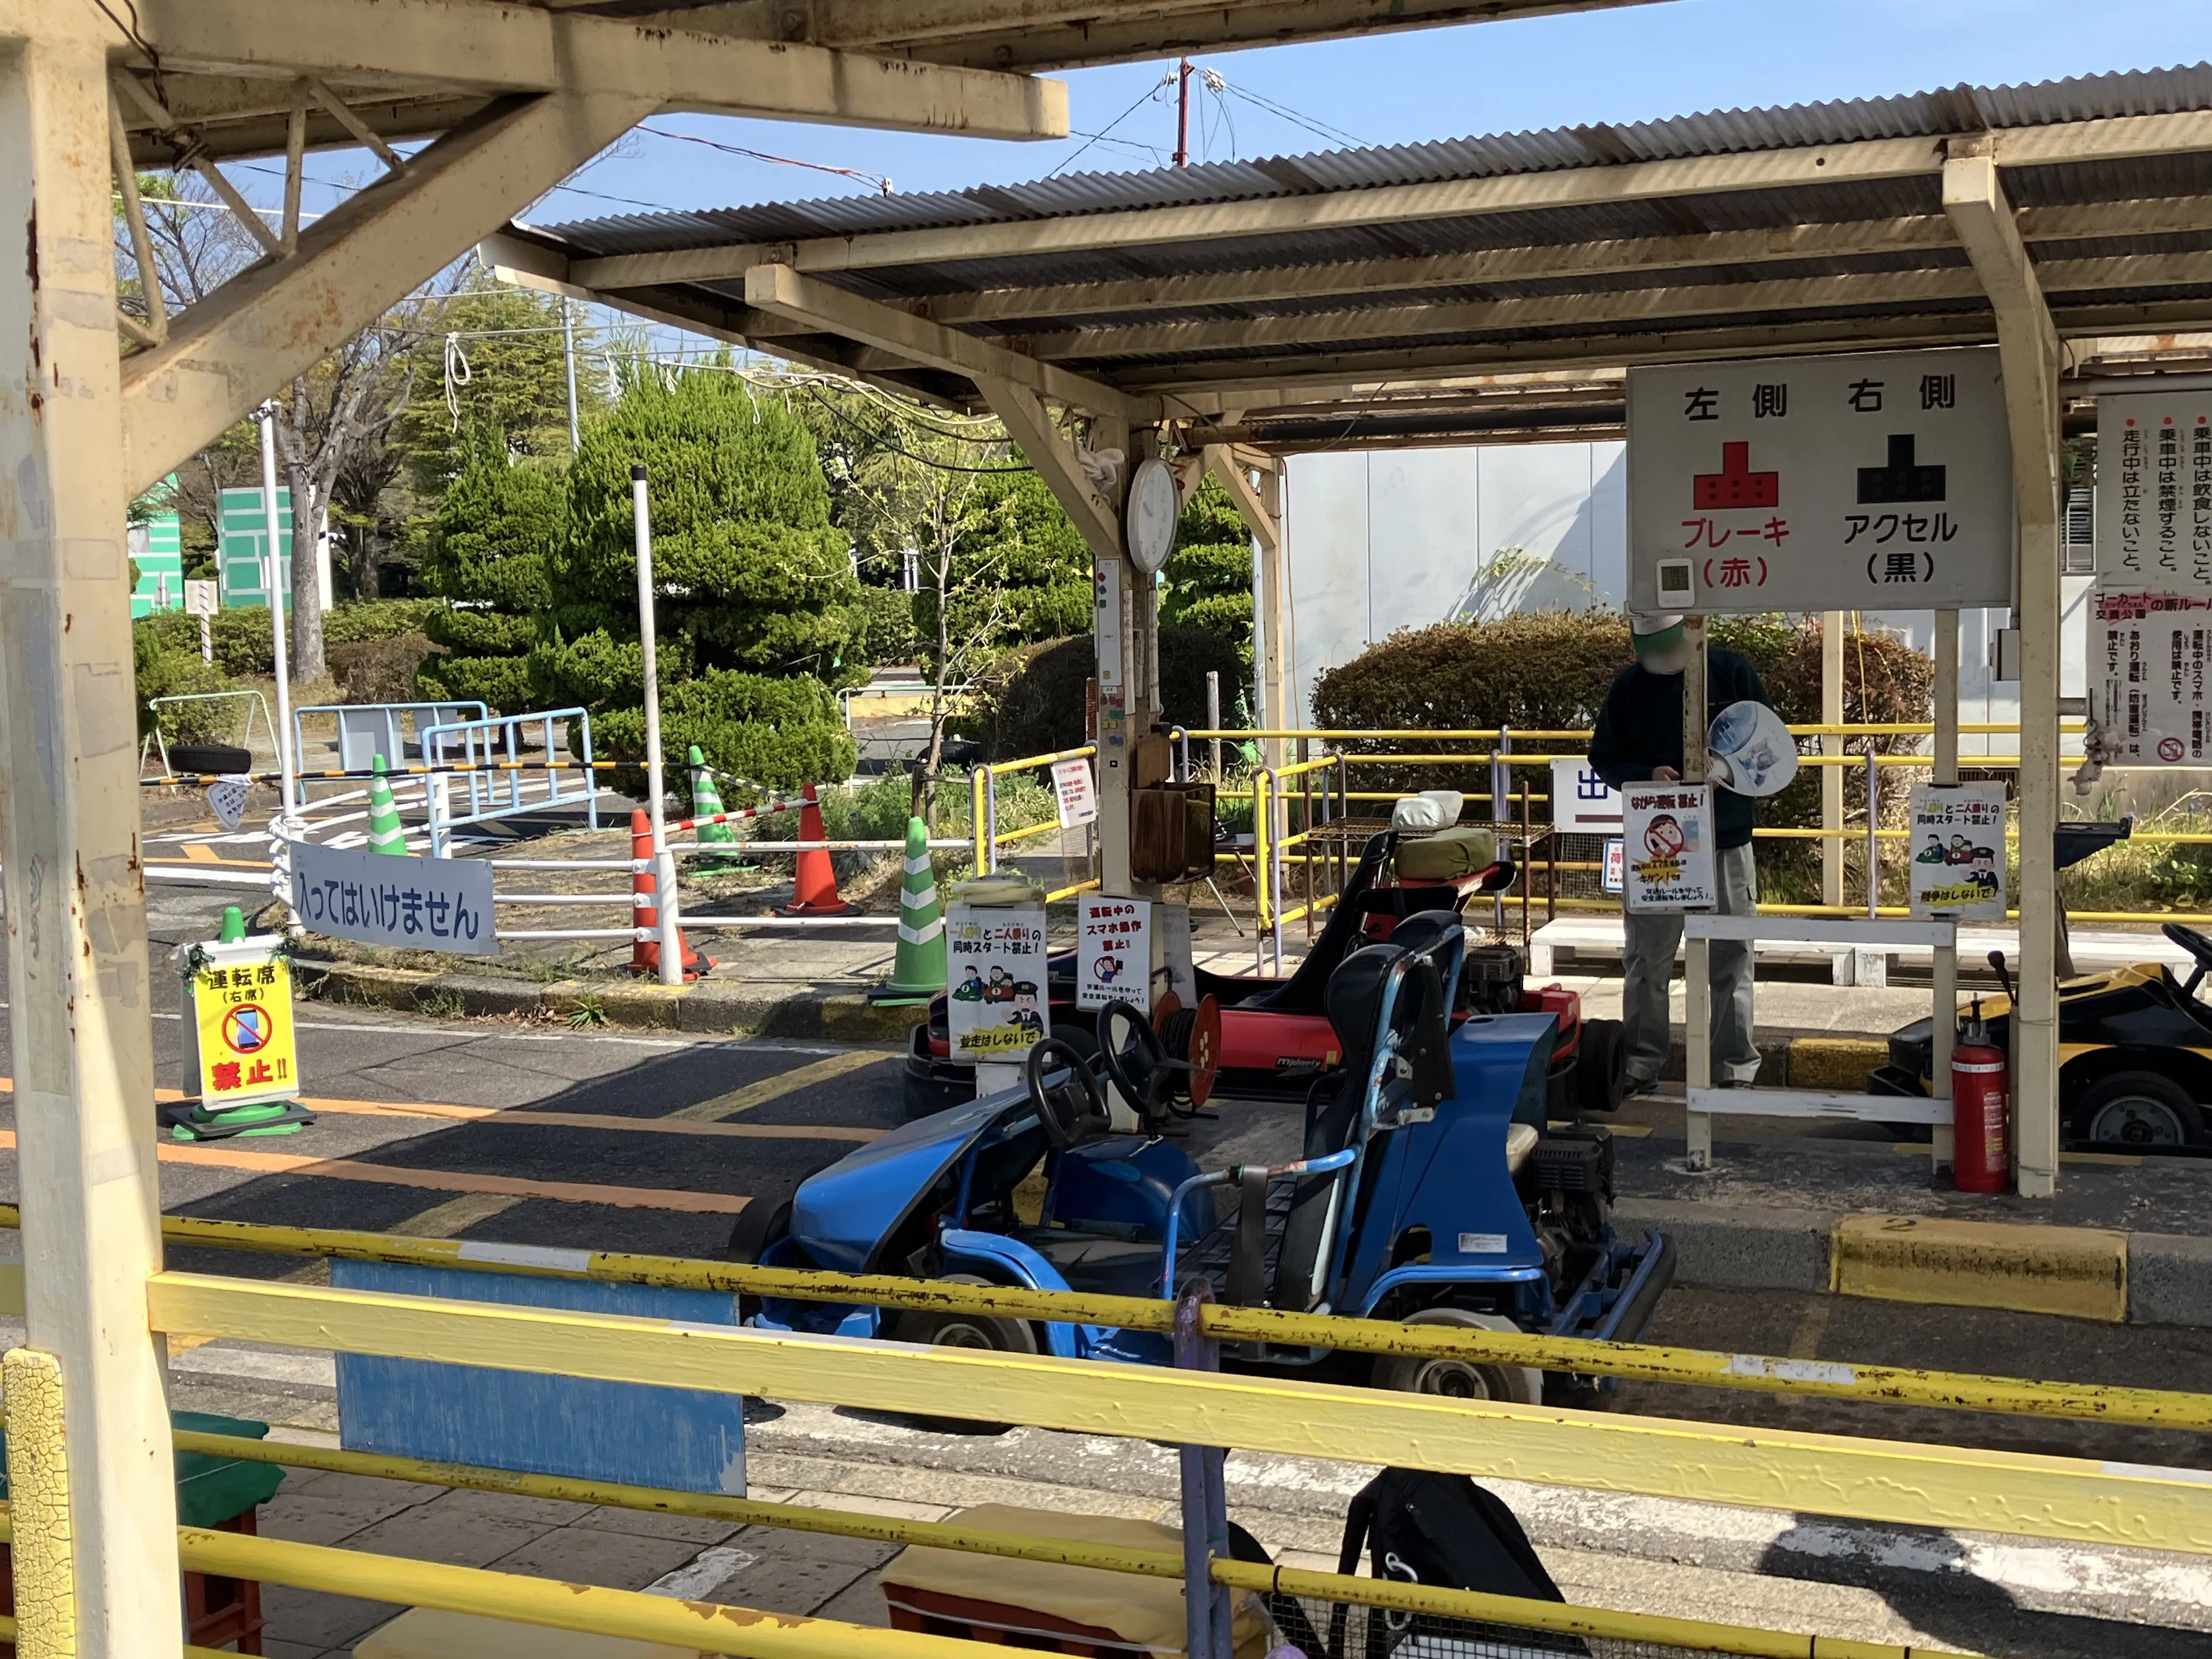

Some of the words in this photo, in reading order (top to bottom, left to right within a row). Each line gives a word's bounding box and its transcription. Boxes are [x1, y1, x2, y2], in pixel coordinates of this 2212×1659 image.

[1684, 384, 1787, 421] 左側
[1848, 374, 1955, 412] 右側
[2123, 430, 2141, 571] 走行中は立たないこと。
[2159, 428, 2176, 571] 乗車中は禁煙すること。
[2193, 427, 2211, 585] 乗車中は飲食しないこと。
[1681, 516, 1790, 548] ブレーキ
[1844, 512, 1958, 544] アクセル
[1703, 556, 1768, 588] (赤)
[1867, 552, 1934, 584] (黒)
[2095, 592, 2152, 603] ゴーカート
[2151, 598, 2212, 611] の新ルー
[299, 872, 479, 940] 入ってはいけません
[207, 965, 275, 990] 運転席
